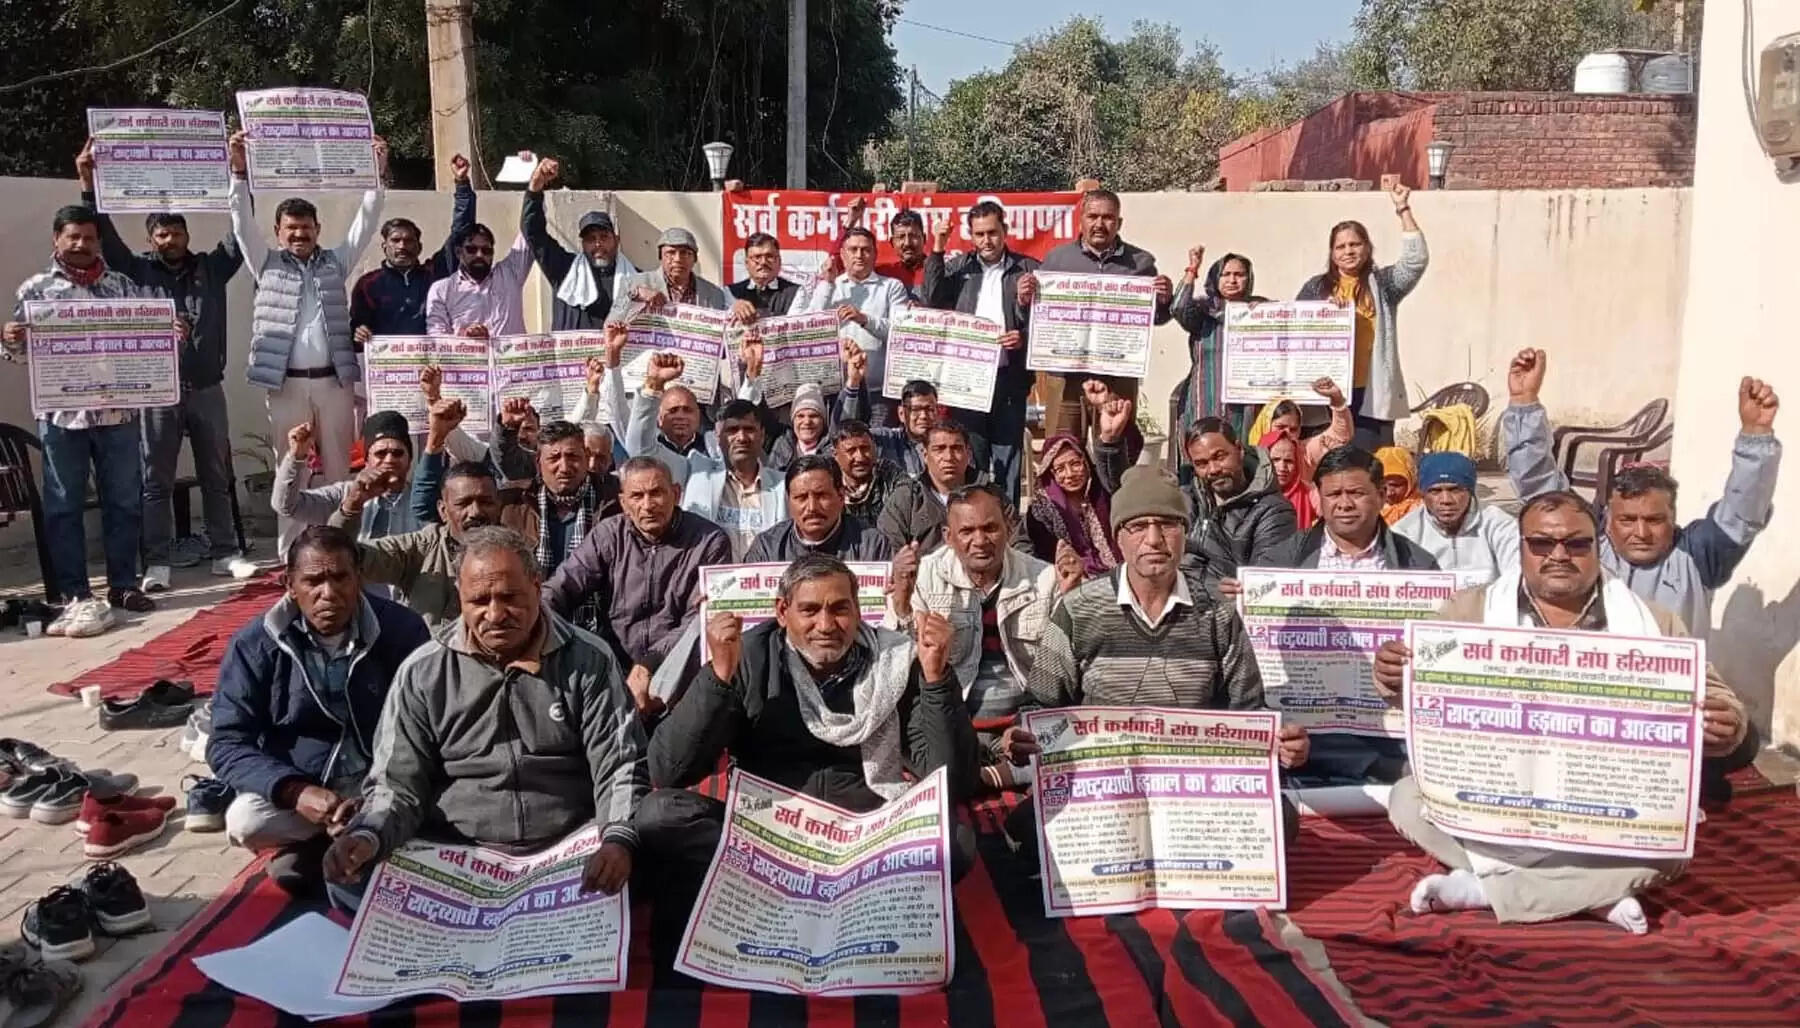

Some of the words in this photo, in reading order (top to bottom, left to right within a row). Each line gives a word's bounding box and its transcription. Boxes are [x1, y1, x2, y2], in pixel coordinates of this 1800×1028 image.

[732, 193, 780, 240] सर्व
[1280, 579, 1304, 598] सर्व
[1308, 579, 1361, 598] कर्मचारी
[1366, 581, 1390, 600] संघ
[1395, 582, 1453, 600] हरियाणा
[1463, 638, 1493, 660] सर्व
[1500, 641, 1570, 667] कर्मचारी
[1576, 647, 1609, 671] संघ
[1615, 649, 1692, 678] हरियाणा
[1415, 696, 1441, 709] 12
[1072, 716, 1101, 736] सर्व
[1104, 716, 1164, 737] कर्मचारी
[1170, 720, 1199, 738] संघ
[1204, 721, 1270, 742] हरियाणा
[1446, 702, 1523, 731] राष्ट्रव्यापी
[1527, 710, 1585, 738] हड़ताल
[1589, 715, 1617, 738] का
[1043, 775, 1066, 789] 12
[1071, 767, 1133, 800] राष्ट्रव्यापी
[1183, 774, 1206, 793] का
[775, 804, 804, 828] सर्व
[805, 816, 863, 844] कर्मचारी
[438, 847, 466, 868] सर्व
[384, 877, 408, 895] 12
[753, 853, 816, 897] राष्ट्रव्यापी
[408, 893, 480, 927] राष्ट्रव्यापी
[534, 890, 557, 909] का
